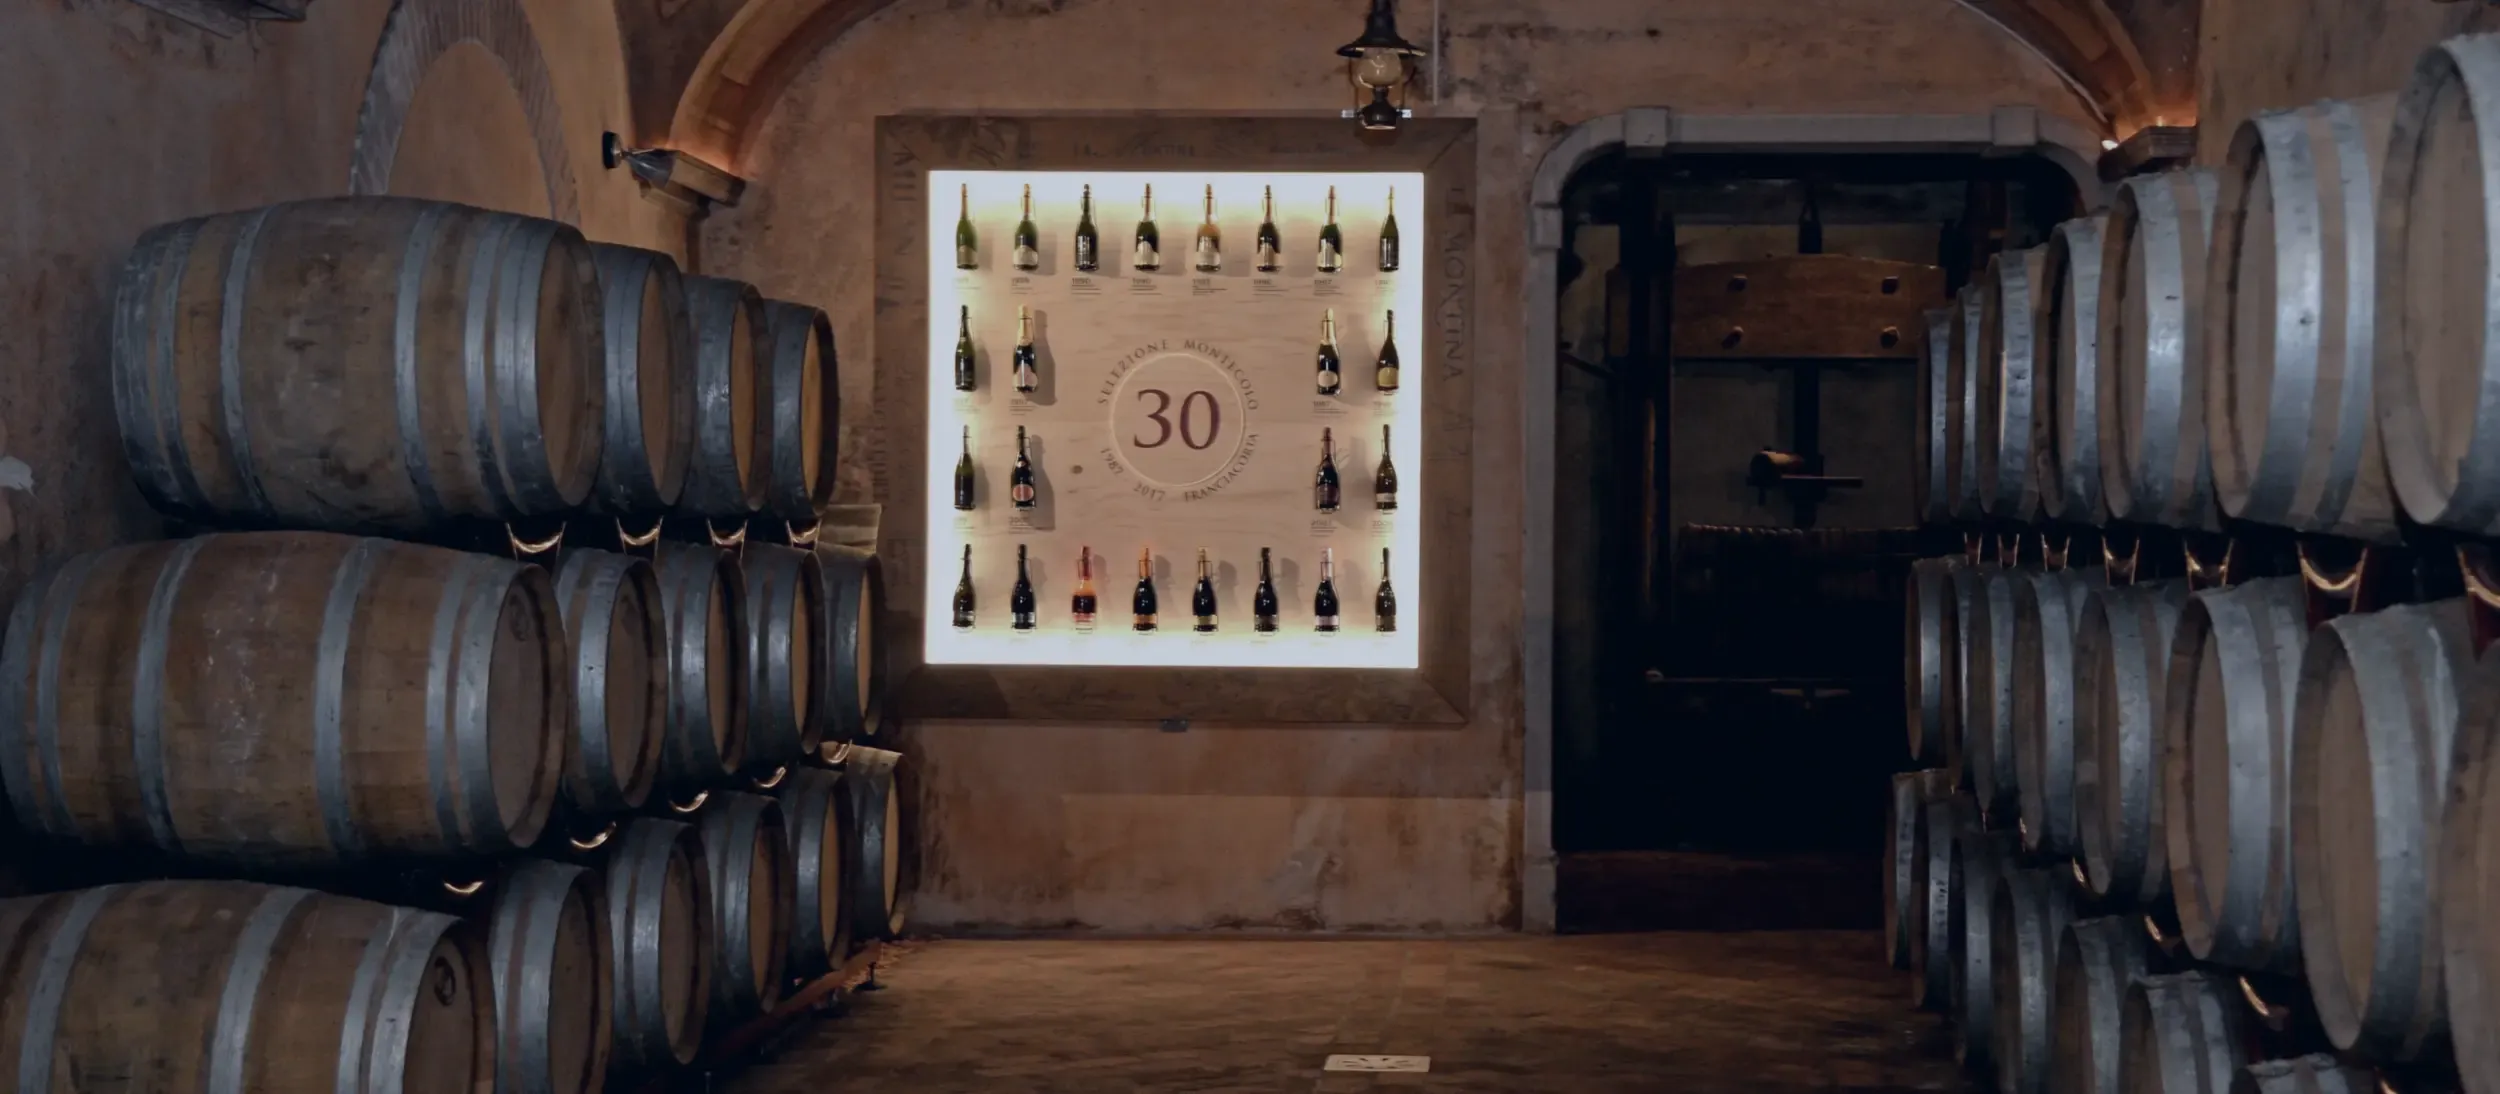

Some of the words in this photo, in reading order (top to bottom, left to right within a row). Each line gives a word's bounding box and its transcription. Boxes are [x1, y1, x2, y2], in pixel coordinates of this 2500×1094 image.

[1098, 340, 1169, 404] SELEZIONE
[1184, 340, 1259, 410] MONTECOLO
[1134, 389, 1219, 450] 30
[1100, 448, 1124, 475] 1987
[1133, 482, 1165, 502] 2017
[1184, 433, 1259, 502] FRANCIACORTA
